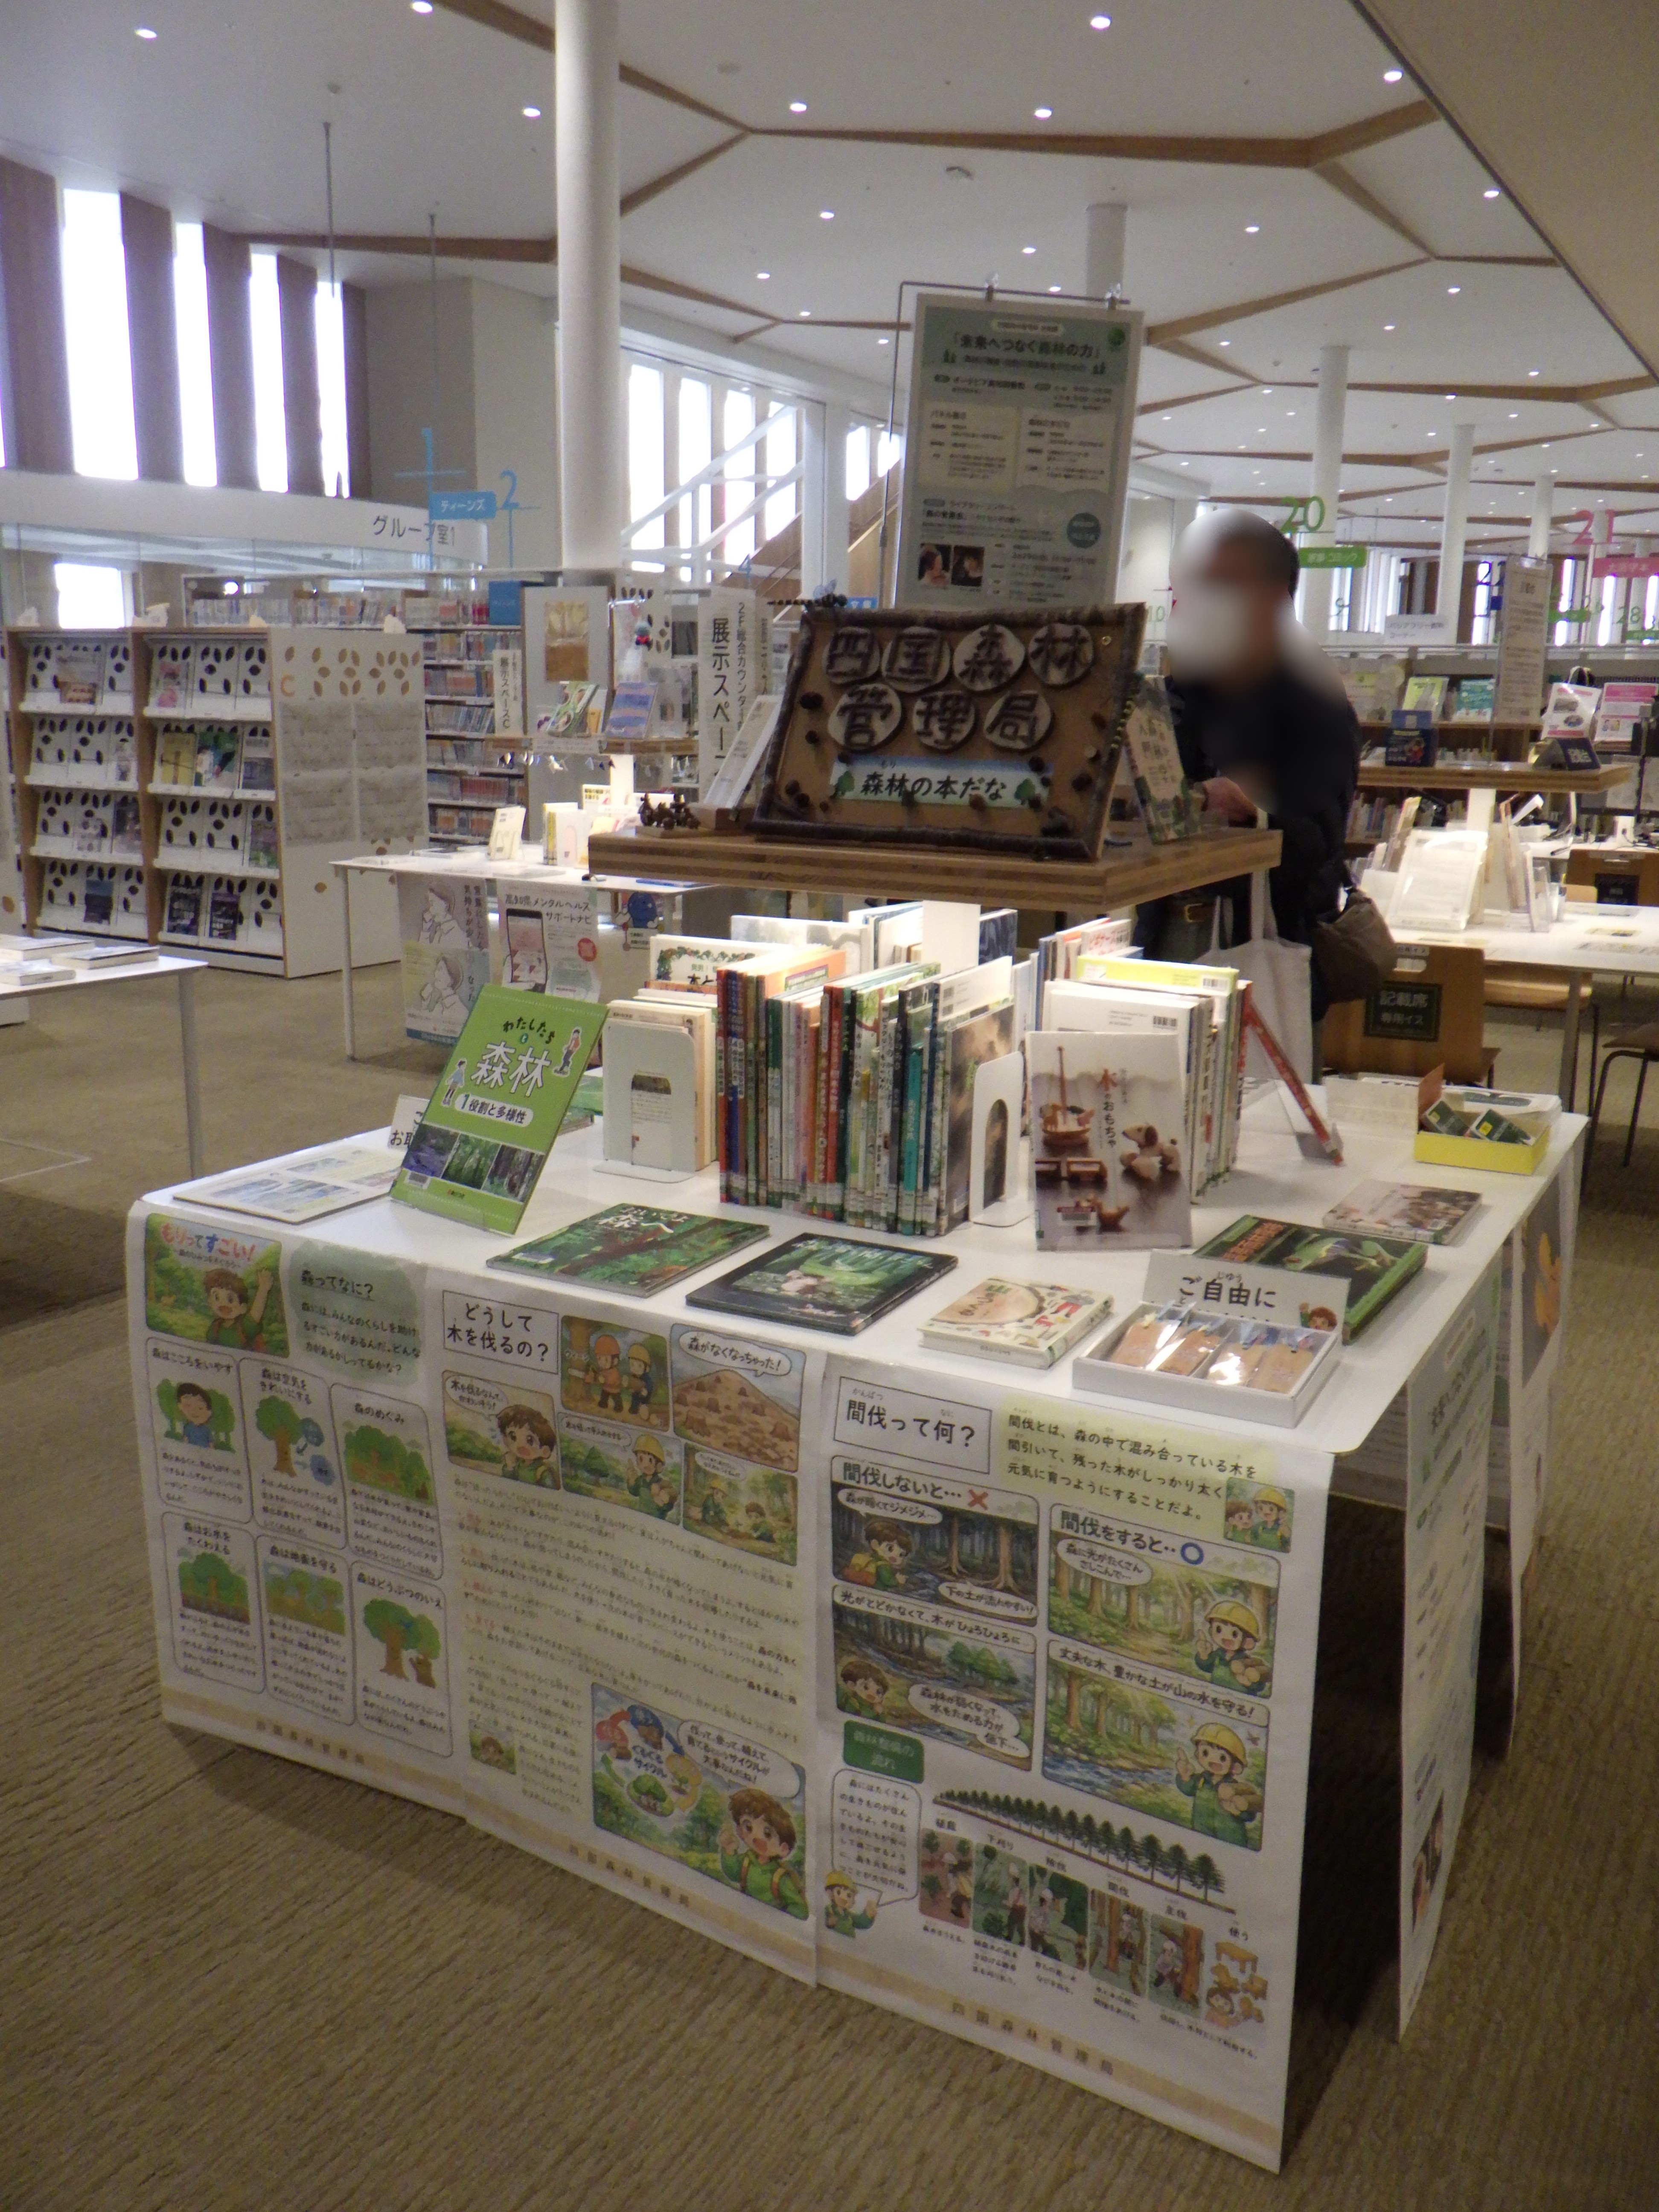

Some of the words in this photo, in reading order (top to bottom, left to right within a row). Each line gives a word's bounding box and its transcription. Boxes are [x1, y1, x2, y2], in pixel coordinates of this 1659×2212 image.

[440, 498, 486, 512] ティーンズ
[500, 470, 519, 509] 2
[1281, 496, 1324, 532] 20
[1574, 510, 1615, 544] 21
[826, 624, 1091, 684] 四国森林
[836, 686, 1039, 750] 管理局
[861, 771, 1007, 801] 森林の本だな
[1380, 990, 1429, 1008] 記載席
[503, 1016, 555, 1044] わたしたち
[471, 1040, 552, 1098] 森林
[461, 1094, 470, 1109] 1
[469, 1098, 527, 1124] 役割と多様性
[301, 1268, 374, 1300] 森ってなに？
[1179, 1276, 1276, 1308] ご自由に
[465, 1302, 533, 1332] どうして
[446, 1324, 549, 1362] 木を伐るの？
[687, 1336, 782, 1372] 森がなくなっちゃった！
[846, 1399, 976, 1448] 間伐って何？
[1008, 1413, 1257, 1479] 間伐とは、森の中で混み合っている木を
[1008, 1438, 1223, 1499] 間引いて、残った木がしっかり太く
[1007, 1461, 1201, 1520] 元気に育つようにすることだよ。
